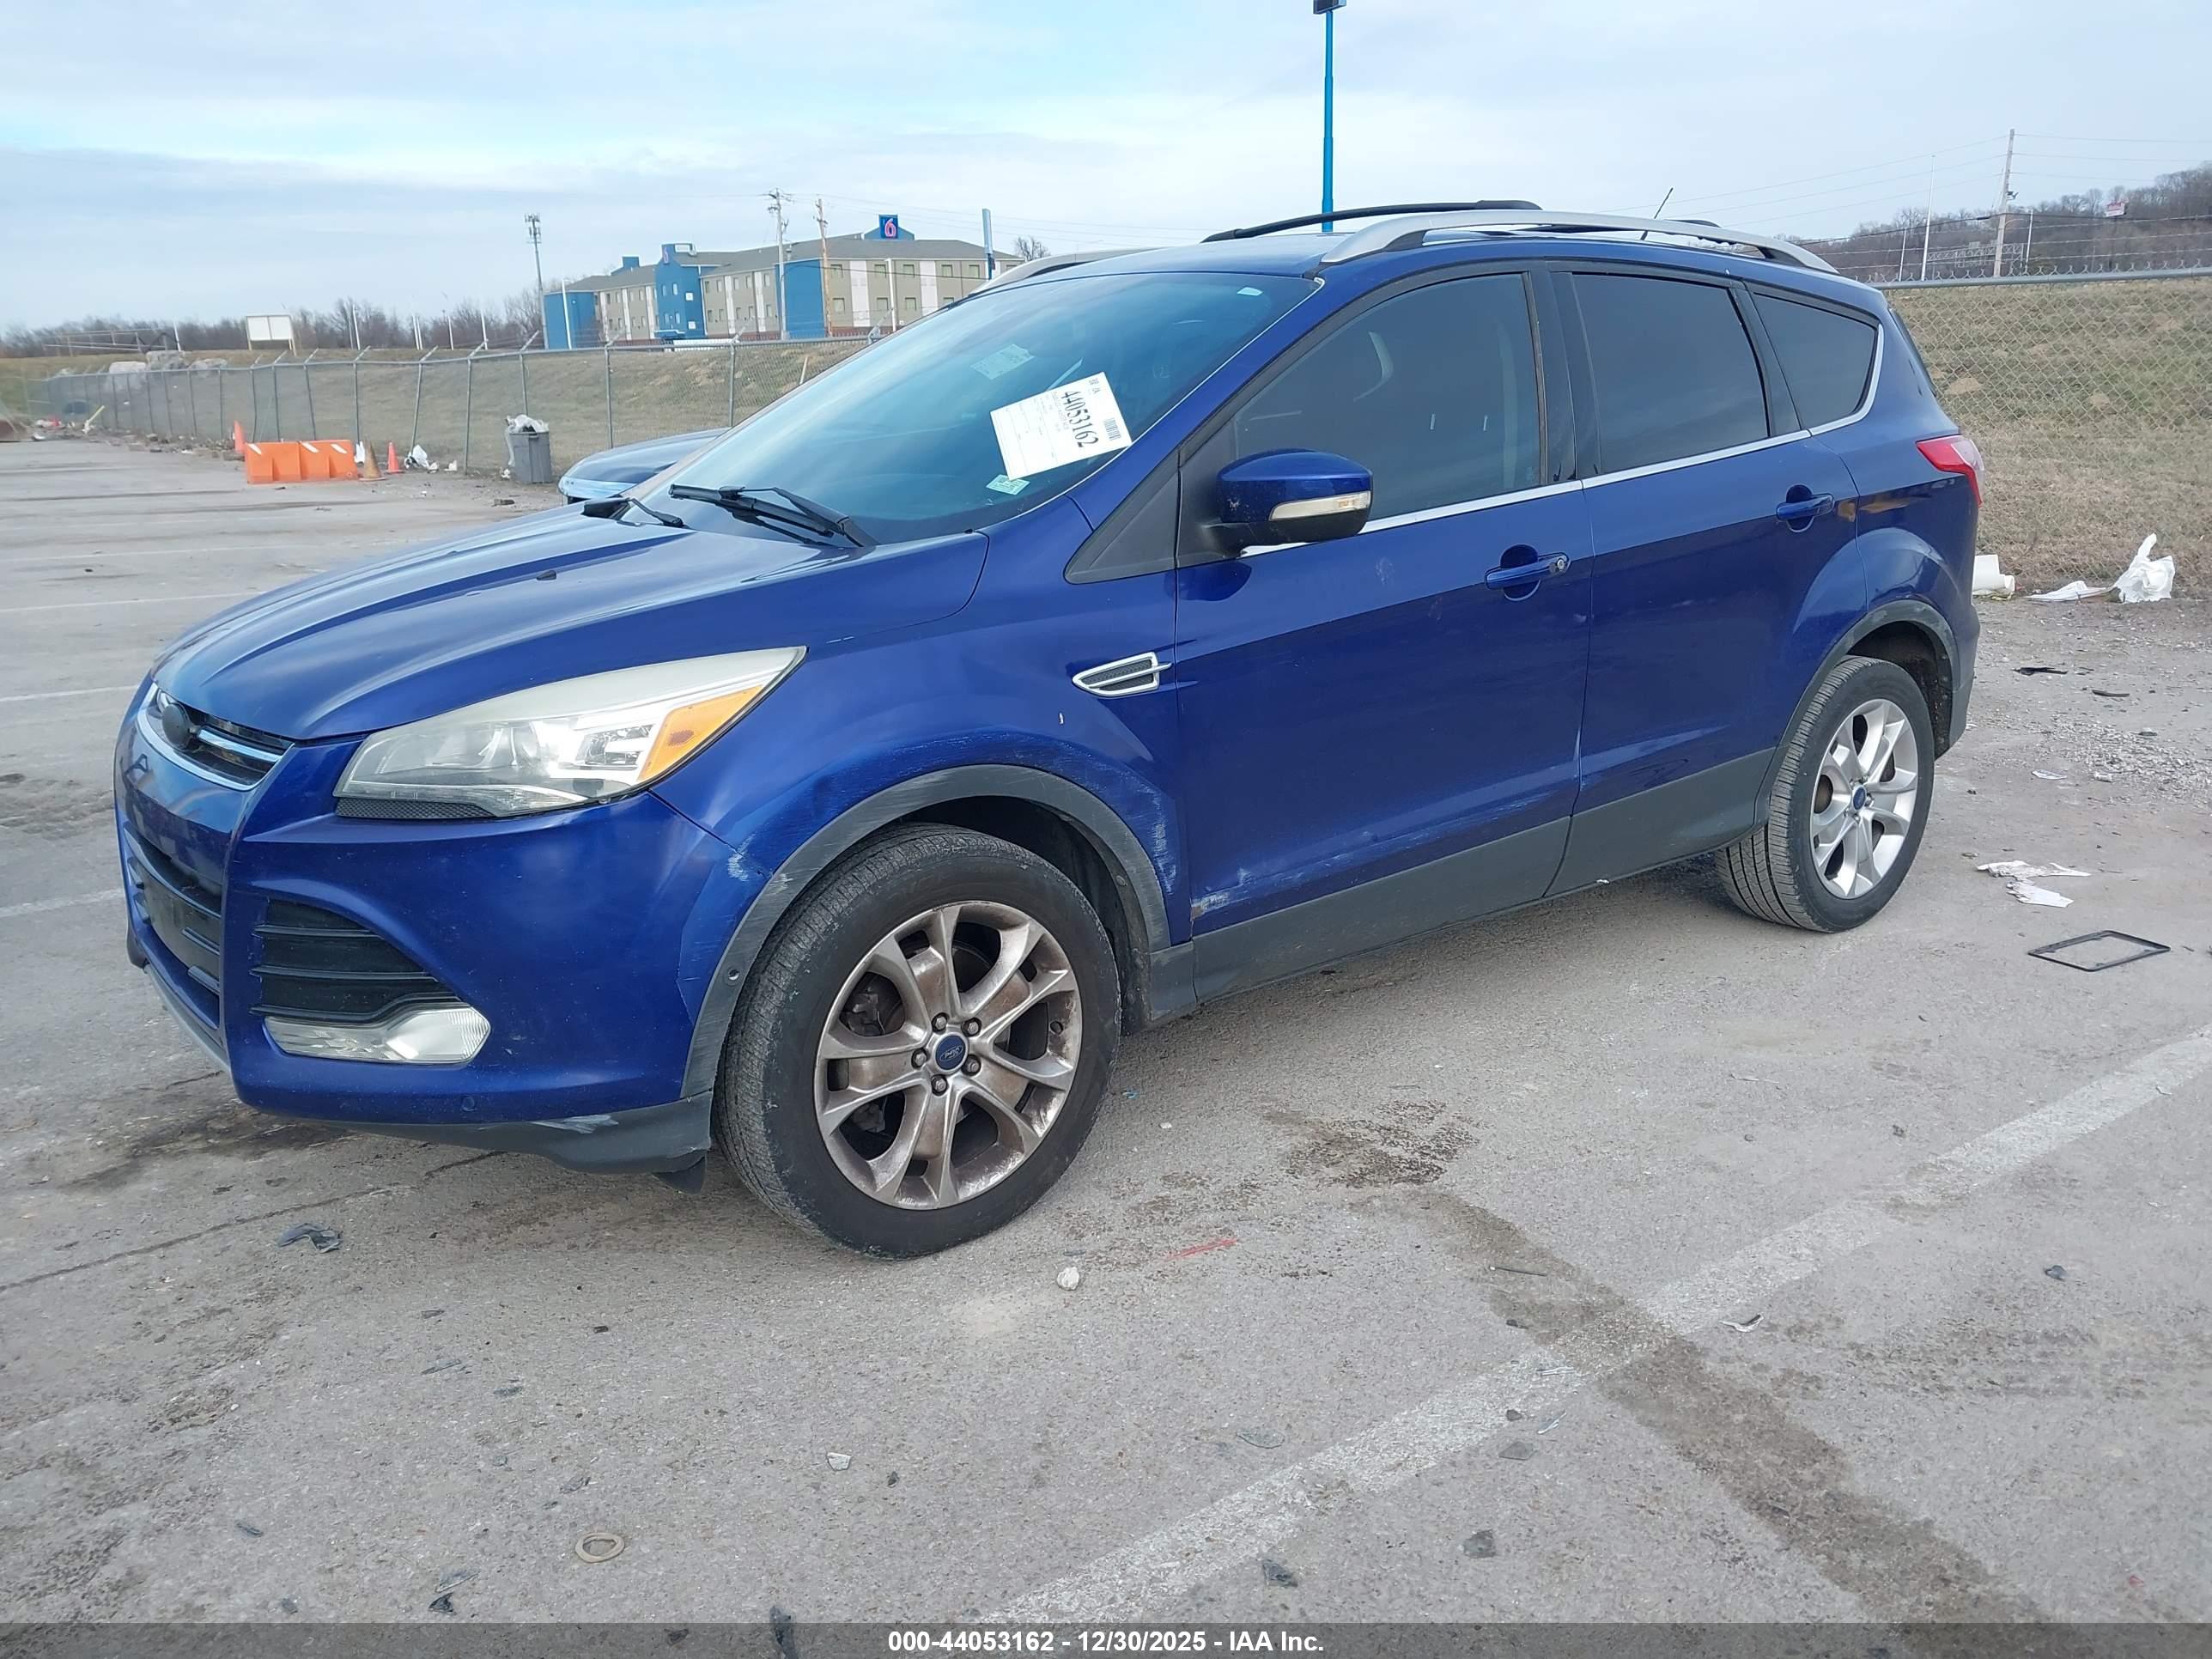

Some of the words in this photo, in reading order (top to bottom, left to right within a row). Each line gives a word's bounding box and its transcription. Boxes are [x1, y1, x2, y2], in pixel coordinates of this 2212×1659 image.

[884, 217, 896, 237] 6
[1060, 391, 1099, 448] 44053162
[944, 1047, 960, 1060] Ford
